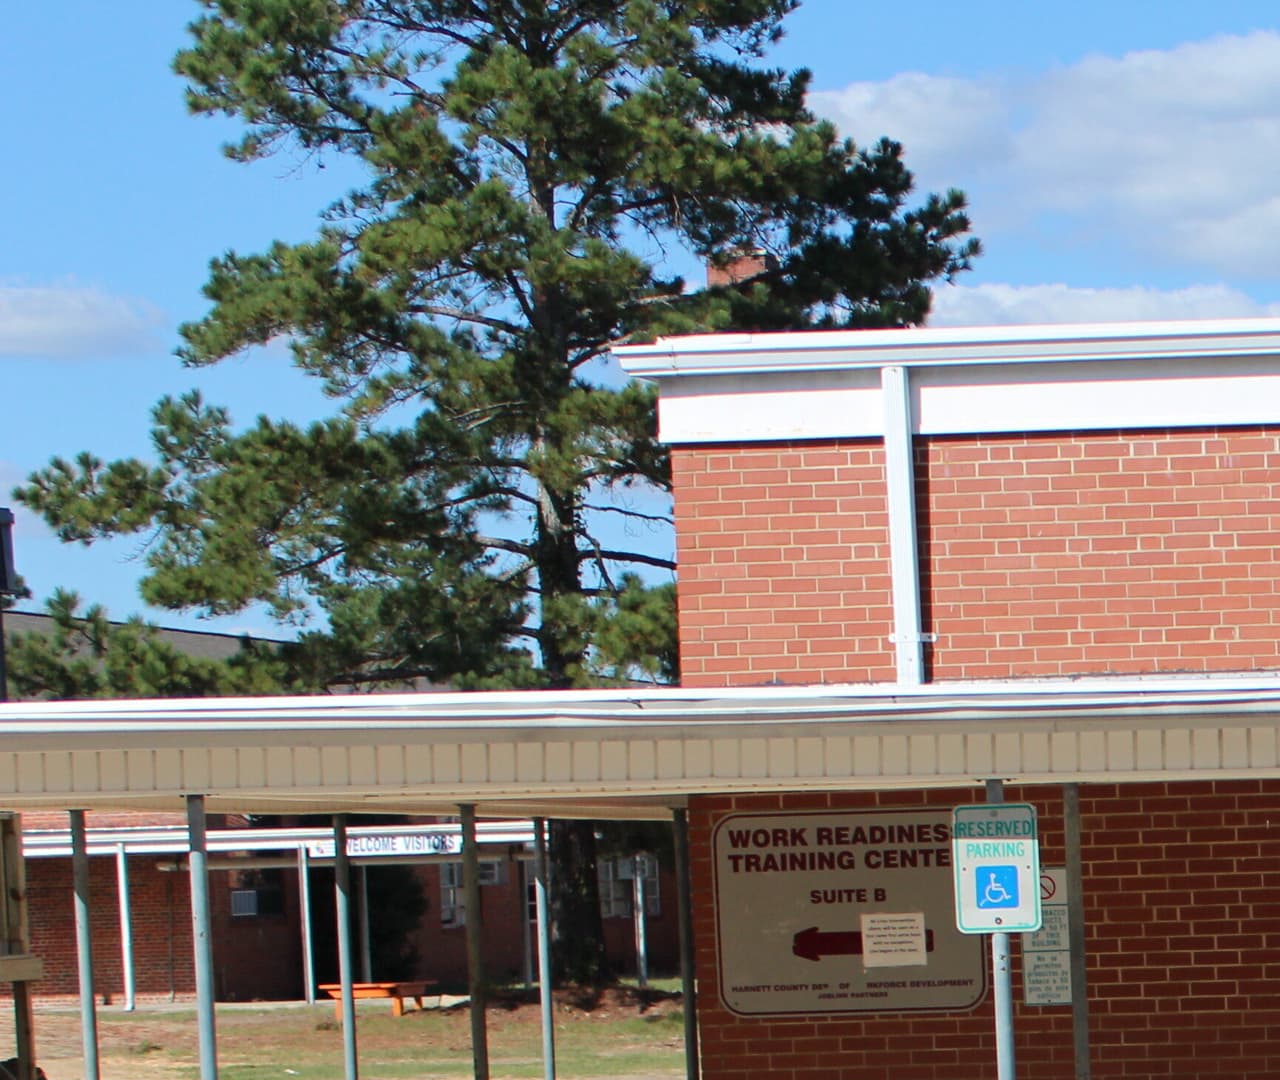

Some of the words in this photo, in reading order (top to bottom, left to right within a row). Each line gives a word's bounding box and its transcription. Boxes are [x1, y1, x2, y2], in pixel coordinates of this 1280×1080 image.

[728, 828, 808, 848] WORK
[815, 824, 952, 847] READINES
[959, 820, 1031, 837] RESERVED
[405, 834, 454, 851] VISITORS
[966, 842, 1025, 859] PARKING
[728, 849, 855, 873] TRAINING
[864, 848, 951, 870] CENTE
[810, 889, 866, 904] SUITE
[874, 888, 887, 903] B
[731, 984, 772, 993] HARNETT
[774, 983, 809, 992] COUNTY
[909, 979, 974, 988] DEVELOPMENT
